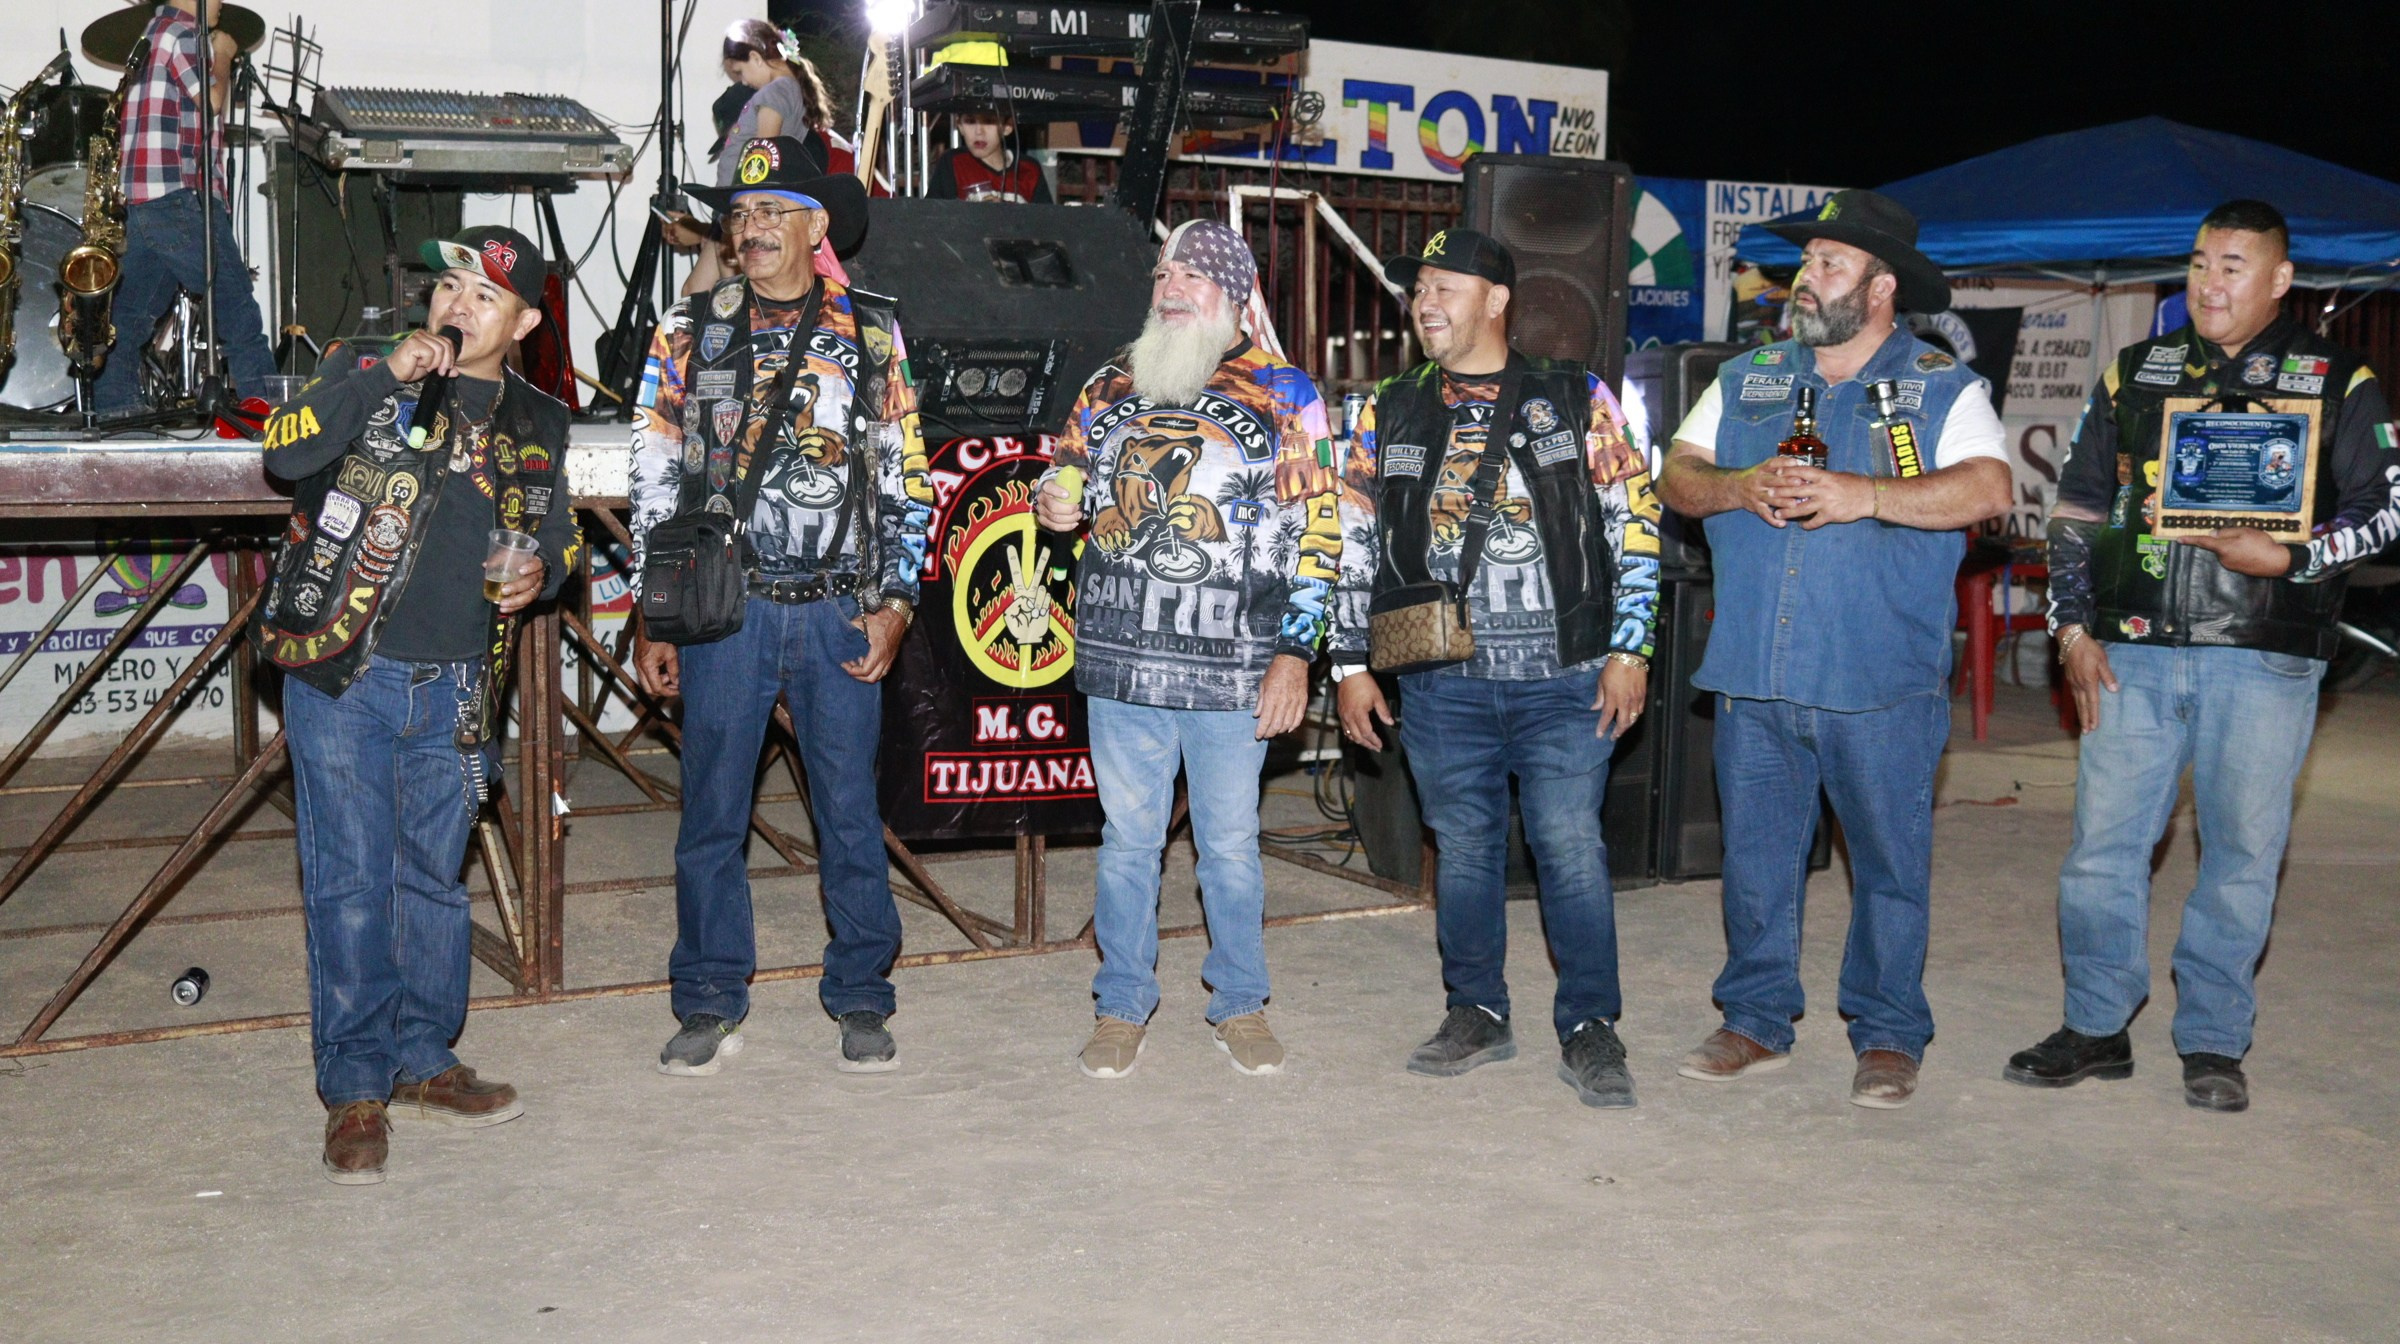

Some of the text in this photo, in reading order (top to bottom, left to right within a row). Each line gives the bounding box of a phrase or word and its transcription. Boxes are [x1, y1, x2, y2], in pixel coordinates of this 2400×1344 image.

[1050, 8, 1088, 36] M1
[761, 139, 780, 168] RIDER
[1551, 130, 1601, 156] LEON
[1747, 376, 1791, 386] PERALTA
[1194, 396, 1265, 449] IEJOS
[2205, 420, 2272, 429] RECONOCIMIENTO
[1390, 447, 1420, 456] WILLYS
[1386, 461, 1422, 473] TESORERO
[393, 486, 408, 498] 20
[507, 497, 519, 514] 10
[1238, 506, 1257, 522] MC
[1083, 573, 1142, 611] SAN
[1140, 633, 1236, 658] COLORADO
[2192, 635, 2233, 643] HONDA
[55, 658, 156, 684] MAERO
[930, 757, 1096, 795] TIJUANA
